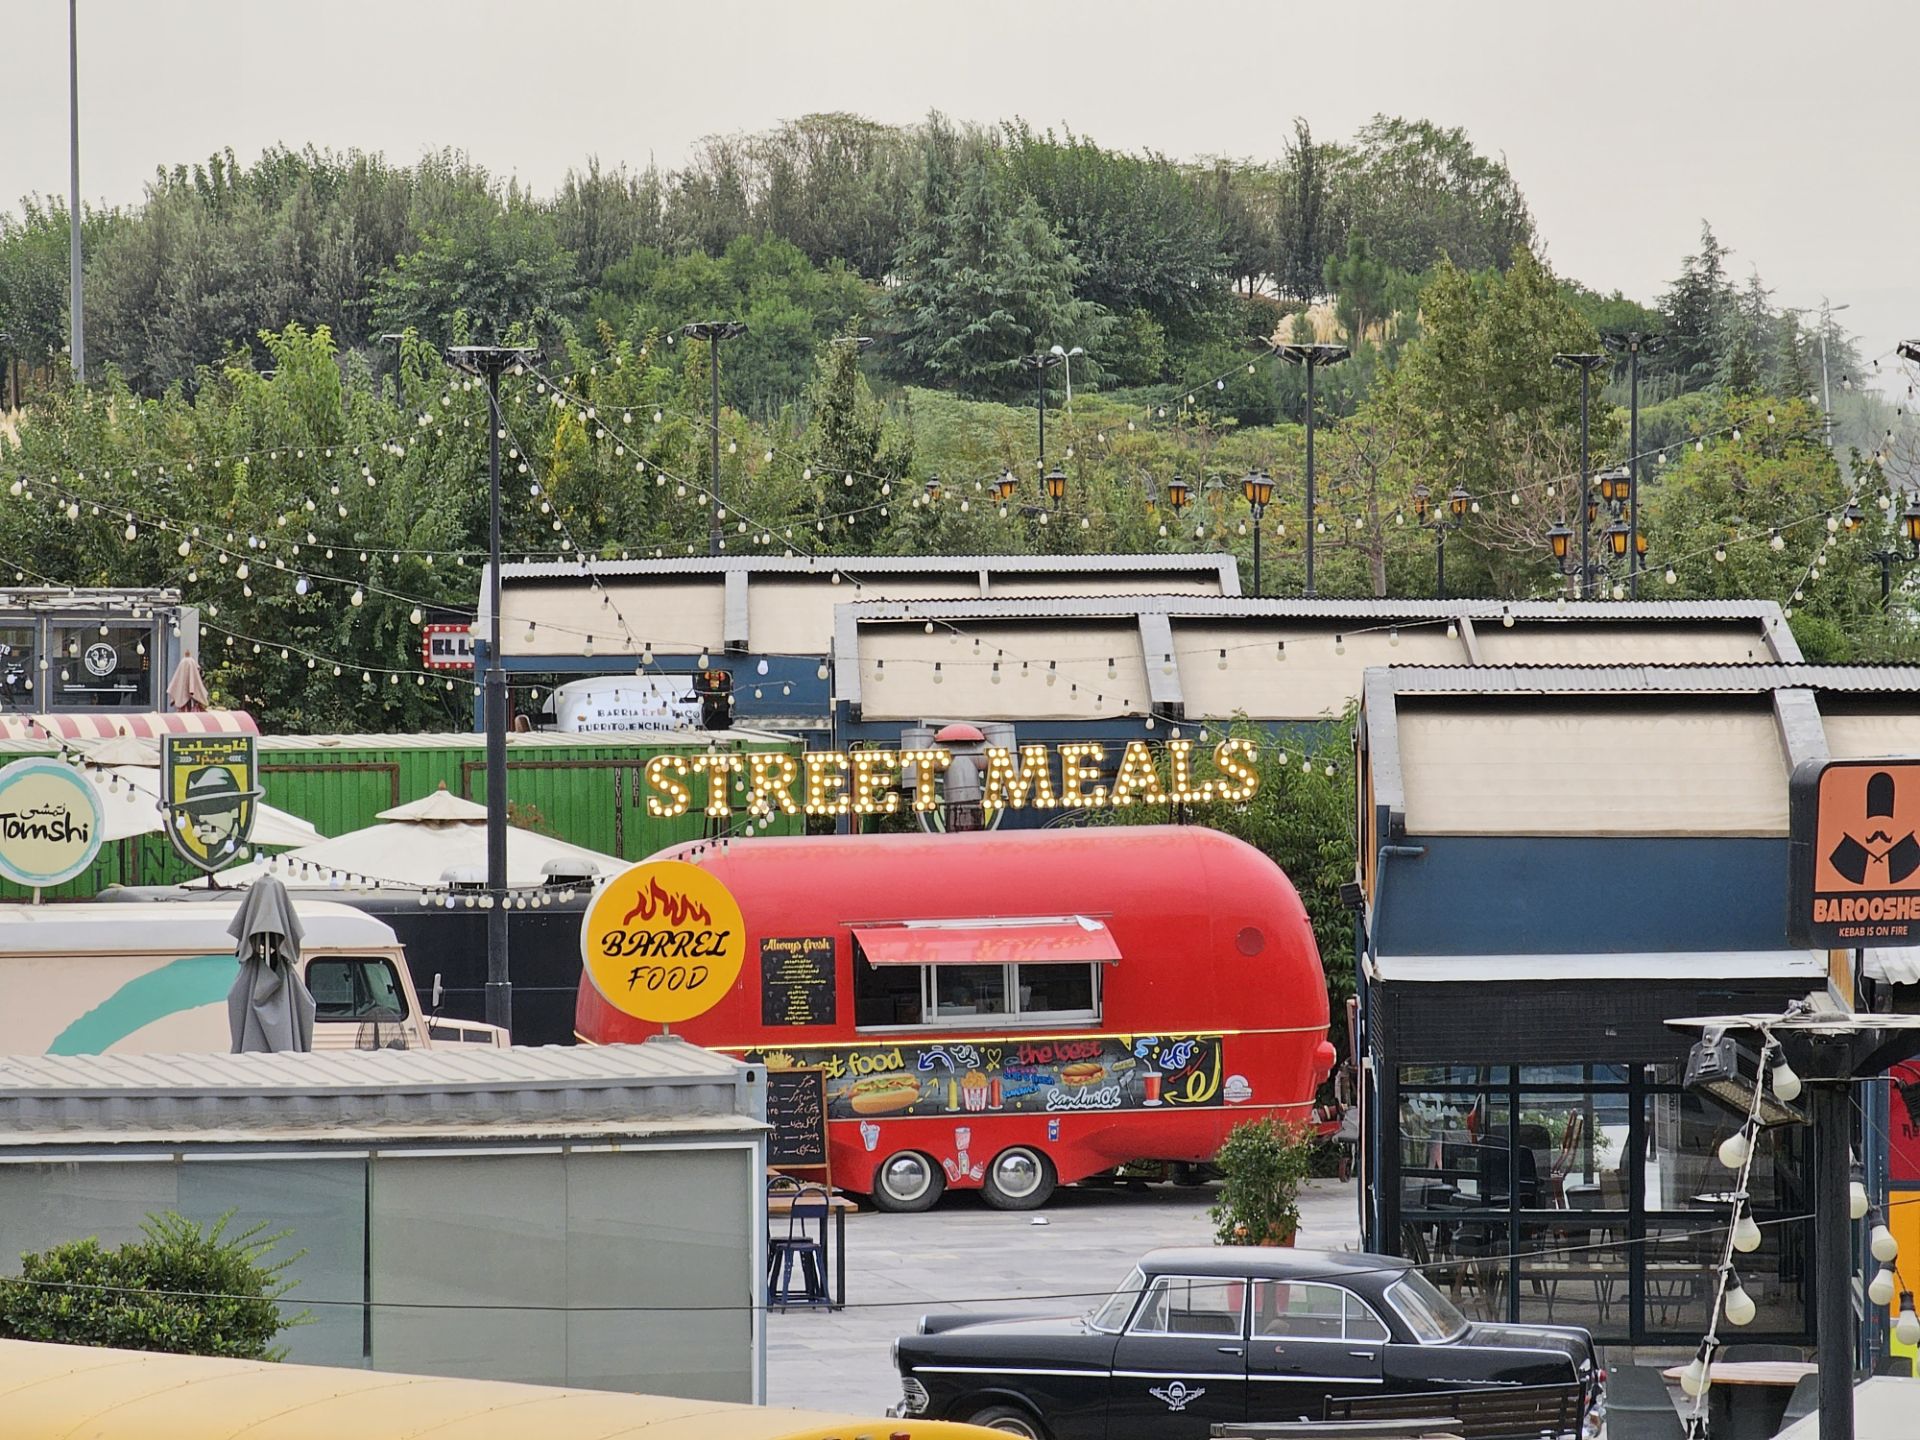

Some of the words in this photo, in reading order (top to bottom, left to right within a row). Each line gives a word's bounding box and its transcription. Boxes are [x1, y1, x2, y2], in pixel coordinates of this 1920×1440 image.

[645, 748, 951, 818] STREET
[980, 738, 1260, 809] MEALS
[0, 811, 89, 844] Tomshi
[601, 930, 731, 958] BARREL
[1839, 926, 1865, 937] KEBAB
[1866, 926, 1875, 936] IS
[1875, 926, 1889, 936] ON
[1890, 925, 1908, 936] FIRE
[763, 938, 802, 954] Always
[803, 937, 831, 954] fresh
[627, 965, 709, 992] FOOD
[848, 1047, 905, 1077] food
[1016, 1043, 1053, 1066] the
